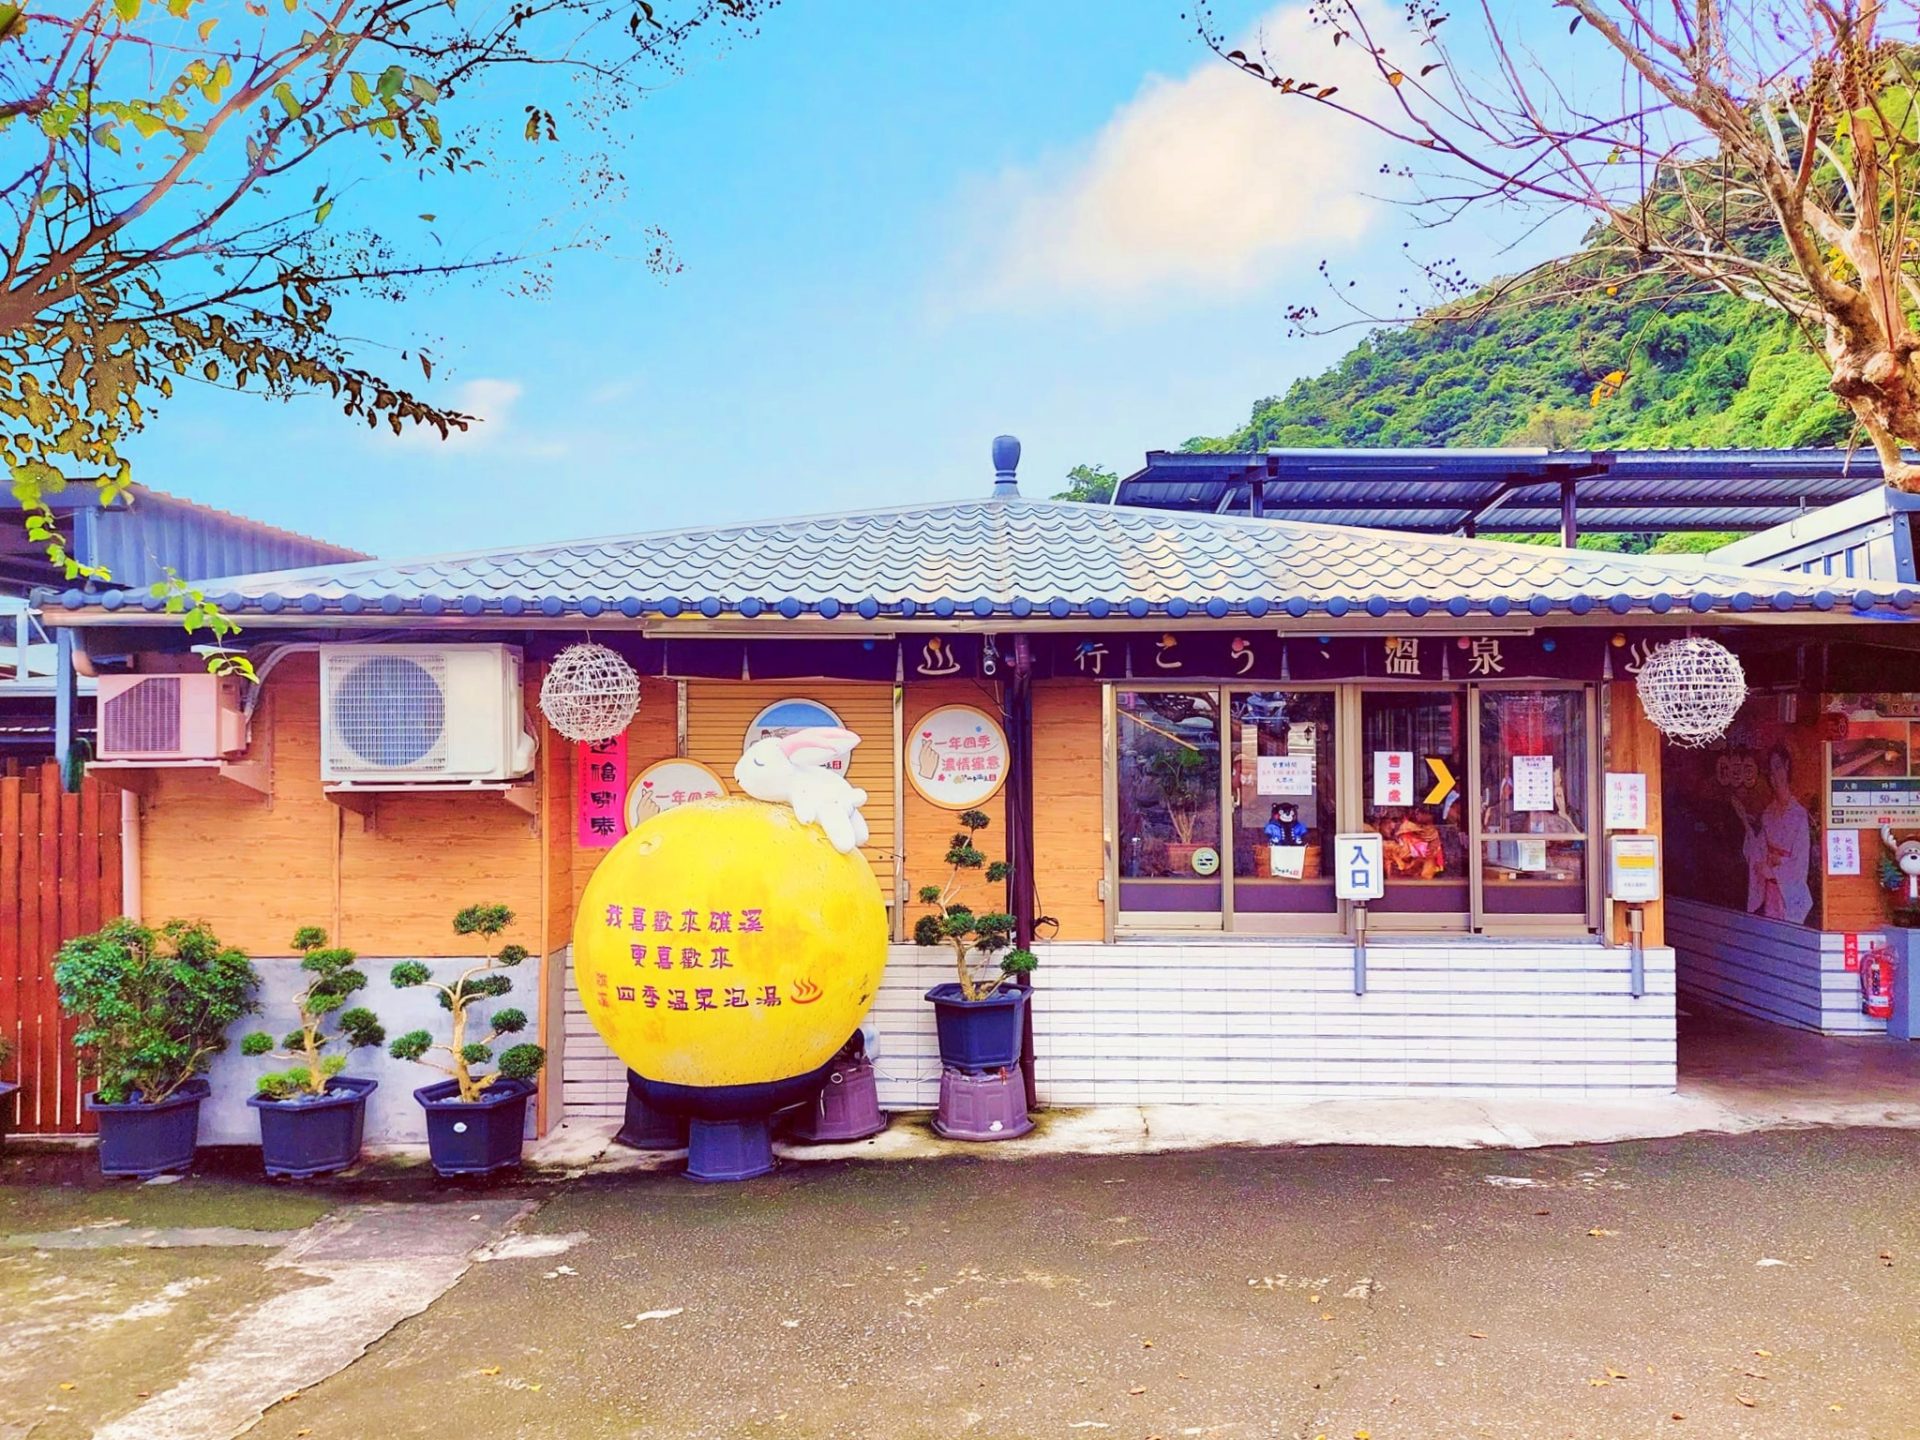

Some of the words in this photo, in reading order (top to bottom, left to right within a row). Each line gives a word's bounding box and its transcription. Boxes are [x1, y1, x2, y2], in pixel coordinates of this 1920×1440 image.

[934, 735, 991, 749] 一年四季
[942, 755, 1000, 771] 濃情蜜意
[1387, 754, 1402, 803] 售票處
[1350, 846, 1370, 888] 入口
[605, 904, 764, 933] 我喜歡來礁溪
[629, 943, 733, 969] 更喜歡來
